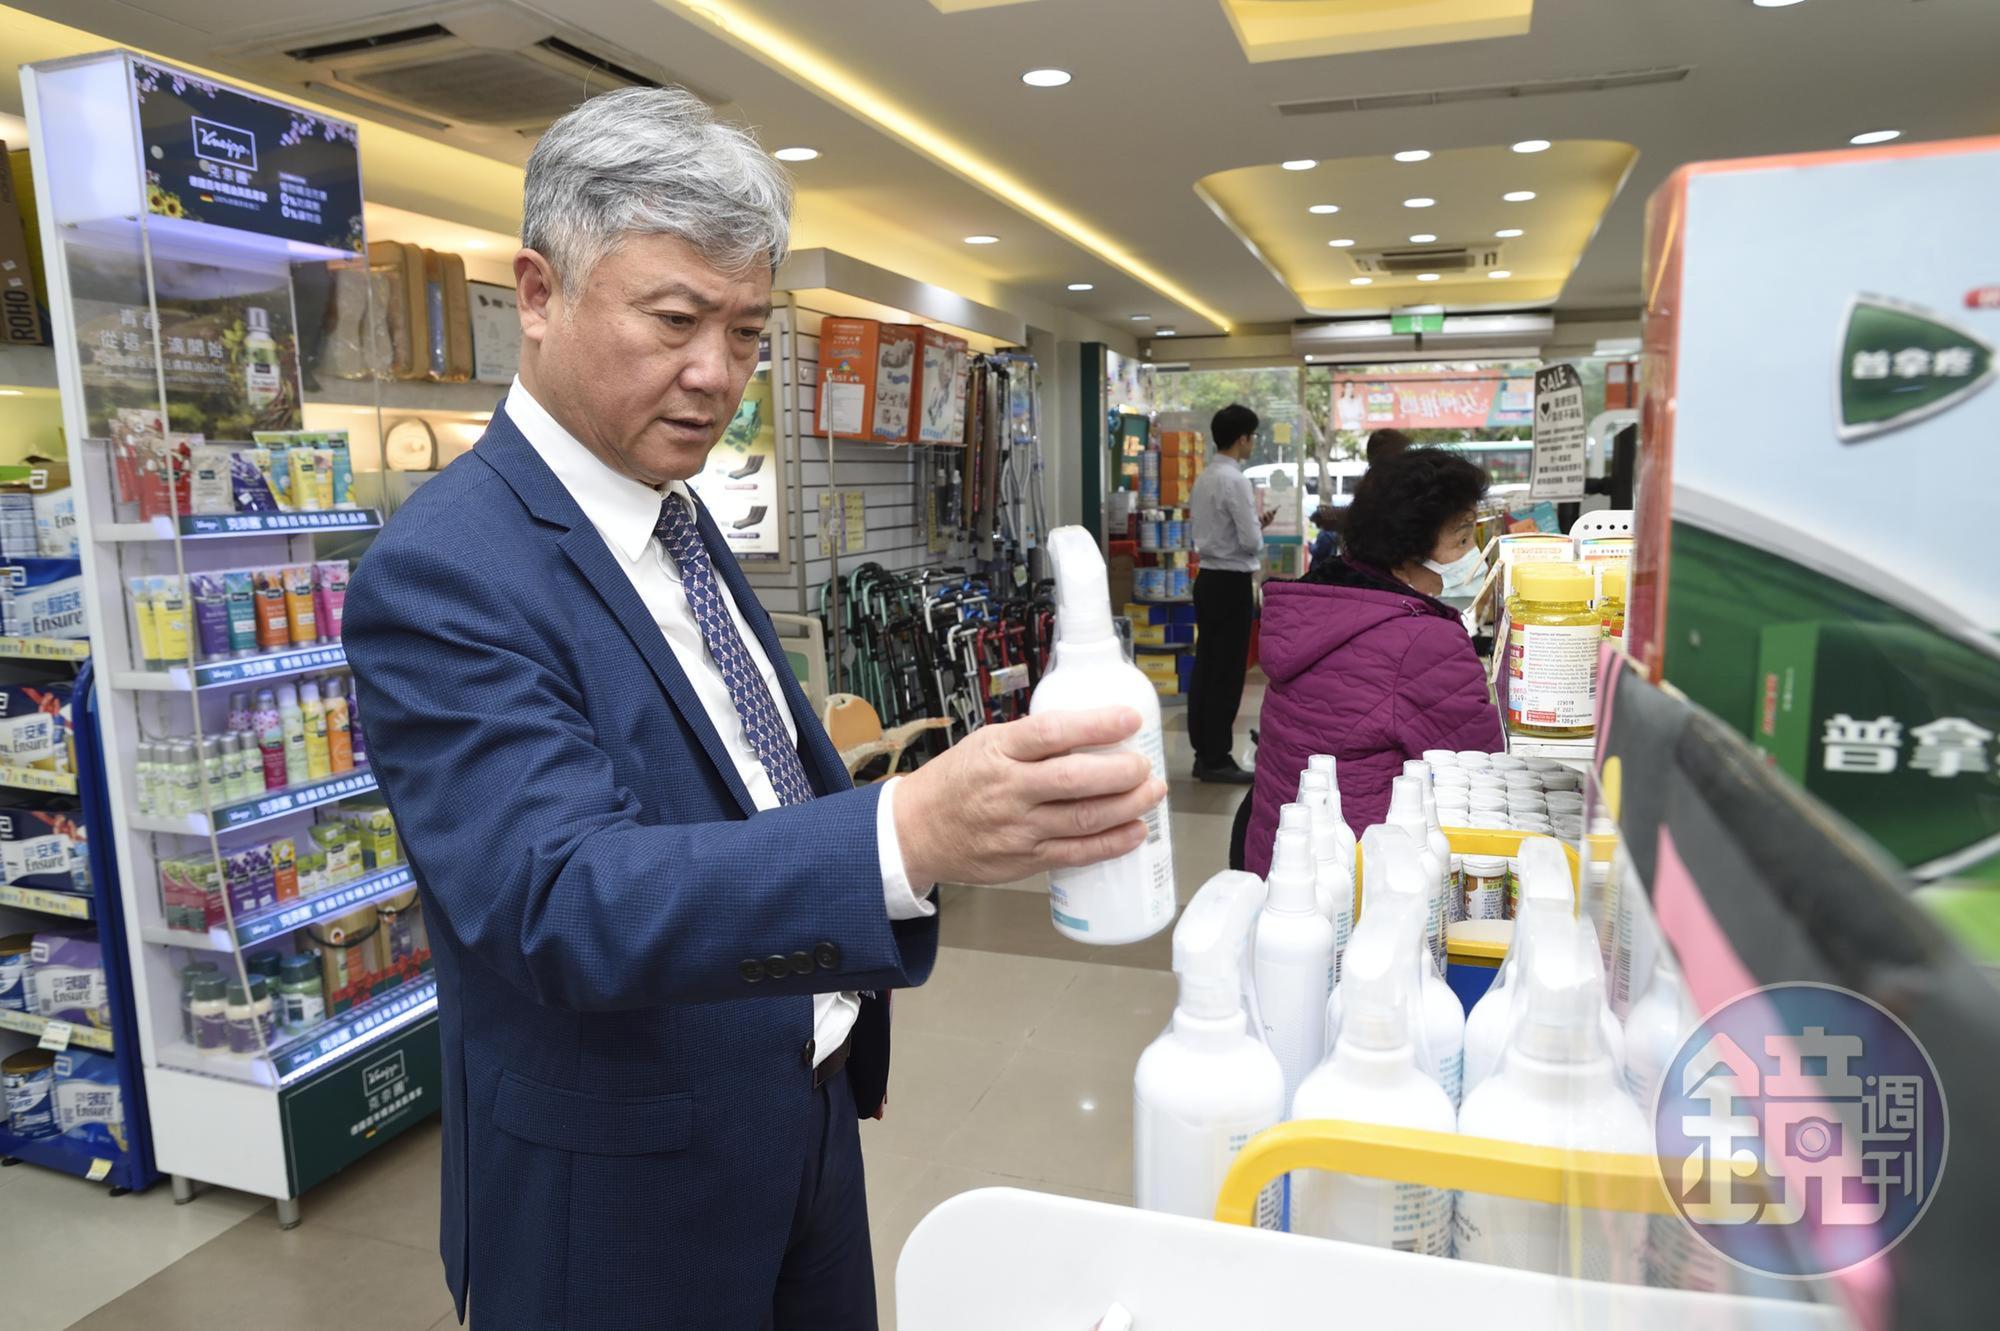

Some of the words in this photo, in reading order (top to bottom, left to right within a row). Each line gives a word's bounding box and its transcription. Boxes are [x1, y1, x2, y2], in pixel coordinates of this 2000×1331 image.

[4, 290, 36, 341] ROHO
[1852, 346, 1973, 379] 普拿疼
[1540, 366, 1567, 392] SALE
[32, 610, 83, 634] Ensure
[13, 737, 49, 753] Ensure
[1821, 713, 2000, 778] 普拿
[24, 855, 65, 873] Ensure
[53, 989, 92, 1004] Ensure
[75, 1102, 114, 1117] Ensure
